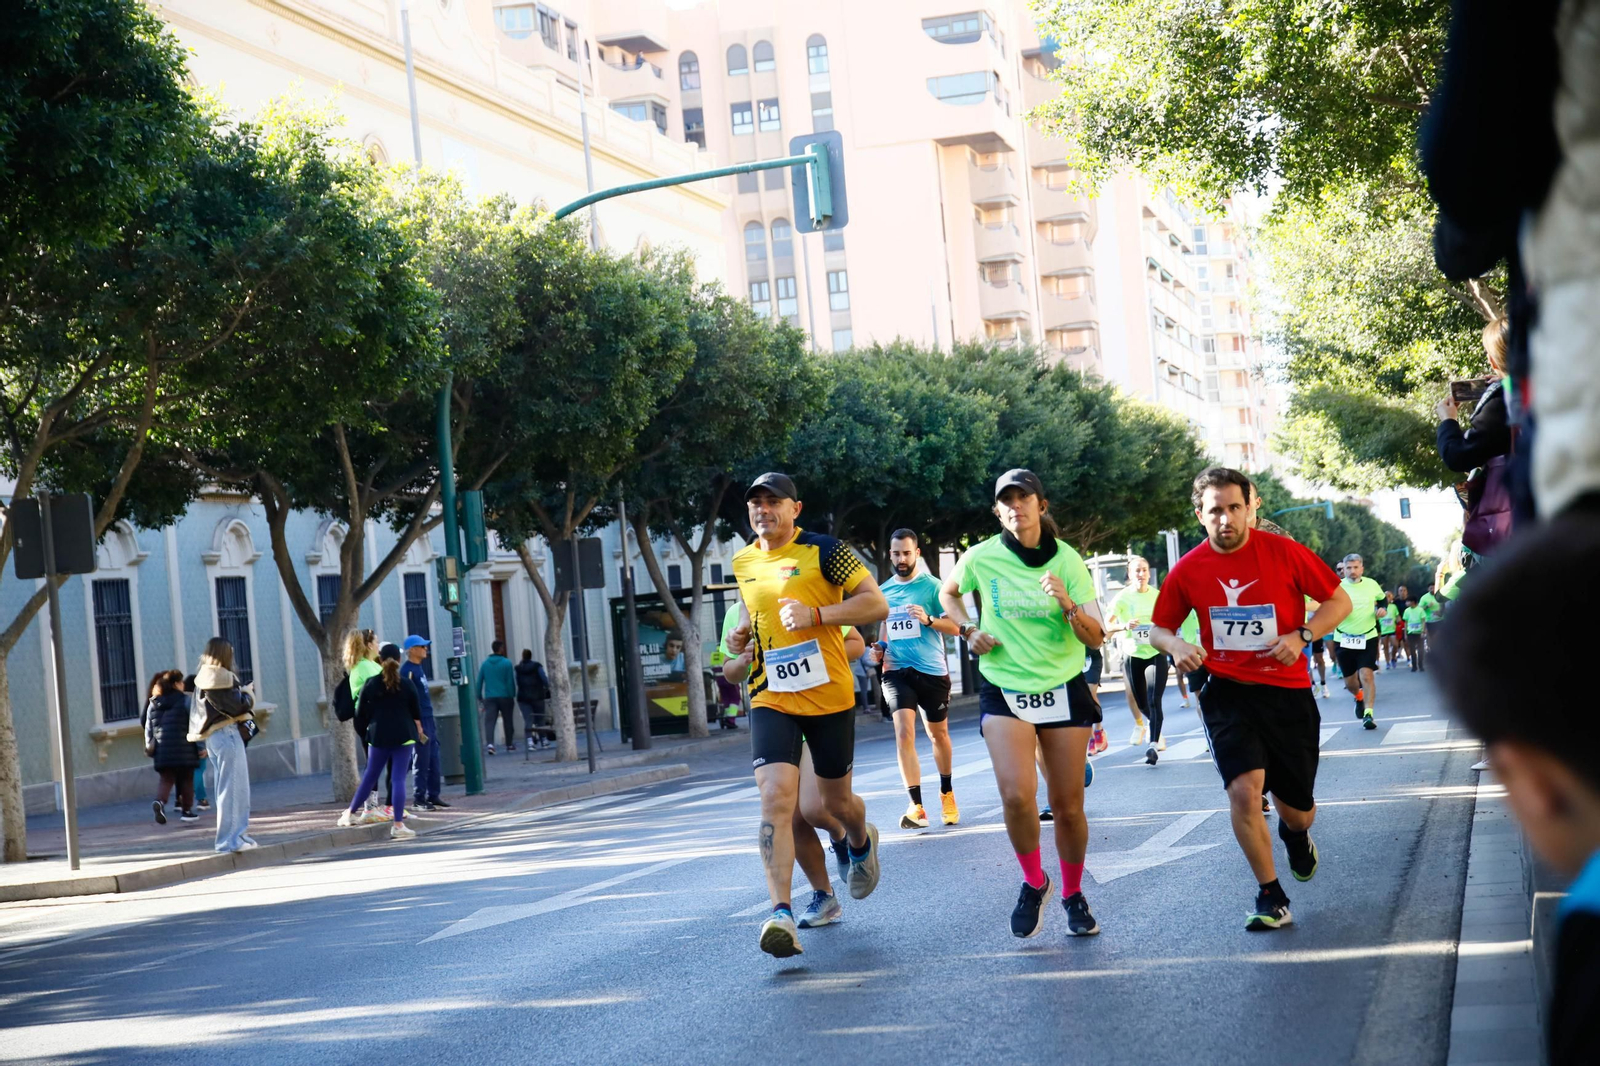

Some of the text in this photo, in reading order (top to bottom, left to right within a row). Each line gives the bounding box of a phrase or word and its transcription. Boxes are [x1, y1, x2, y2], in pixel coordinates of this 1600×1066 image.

[1001, 596, 1050, 607] contra el
[891, 620, 913, 631] 416
[1223, 620, 1264, 636] 773
[776, 658, 811, 679] 801
[1016, 691, 1055, 709] 588
